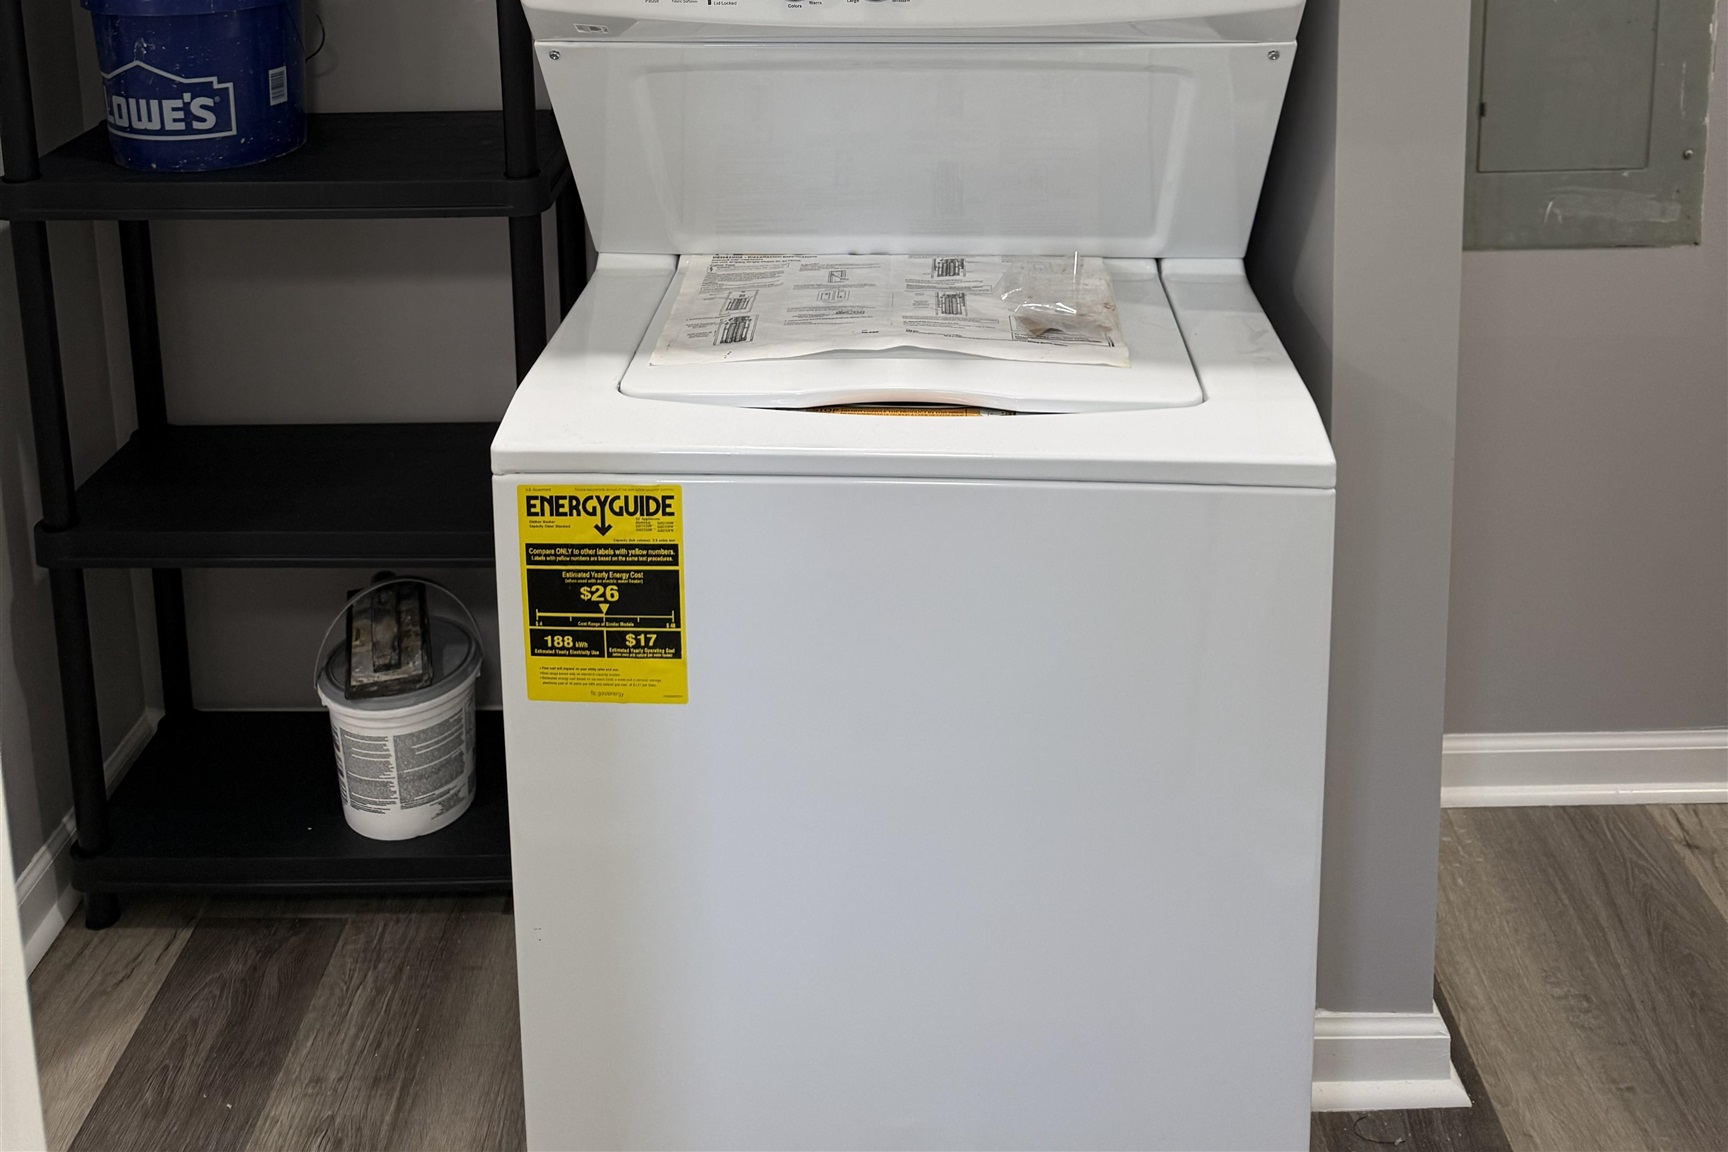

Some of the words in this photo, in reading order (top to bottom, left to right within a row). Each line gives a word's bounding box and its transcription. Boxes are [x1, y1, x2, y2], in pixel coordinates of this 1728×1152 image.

[106, 92, 217, 131] LOWE'S
[526, 495, 675, 517] ENERGYGUIDE
[529, 547, 555, 556] Compare
[628, 548, 647, 556] yellow
[591, 571, 608, 580] Yearly
[609, 571, 629, 580] Energy
[580, 585, 620, 602] $26
[544, 635, 574, 648] 188
[625, 633, 657, 647] $17
